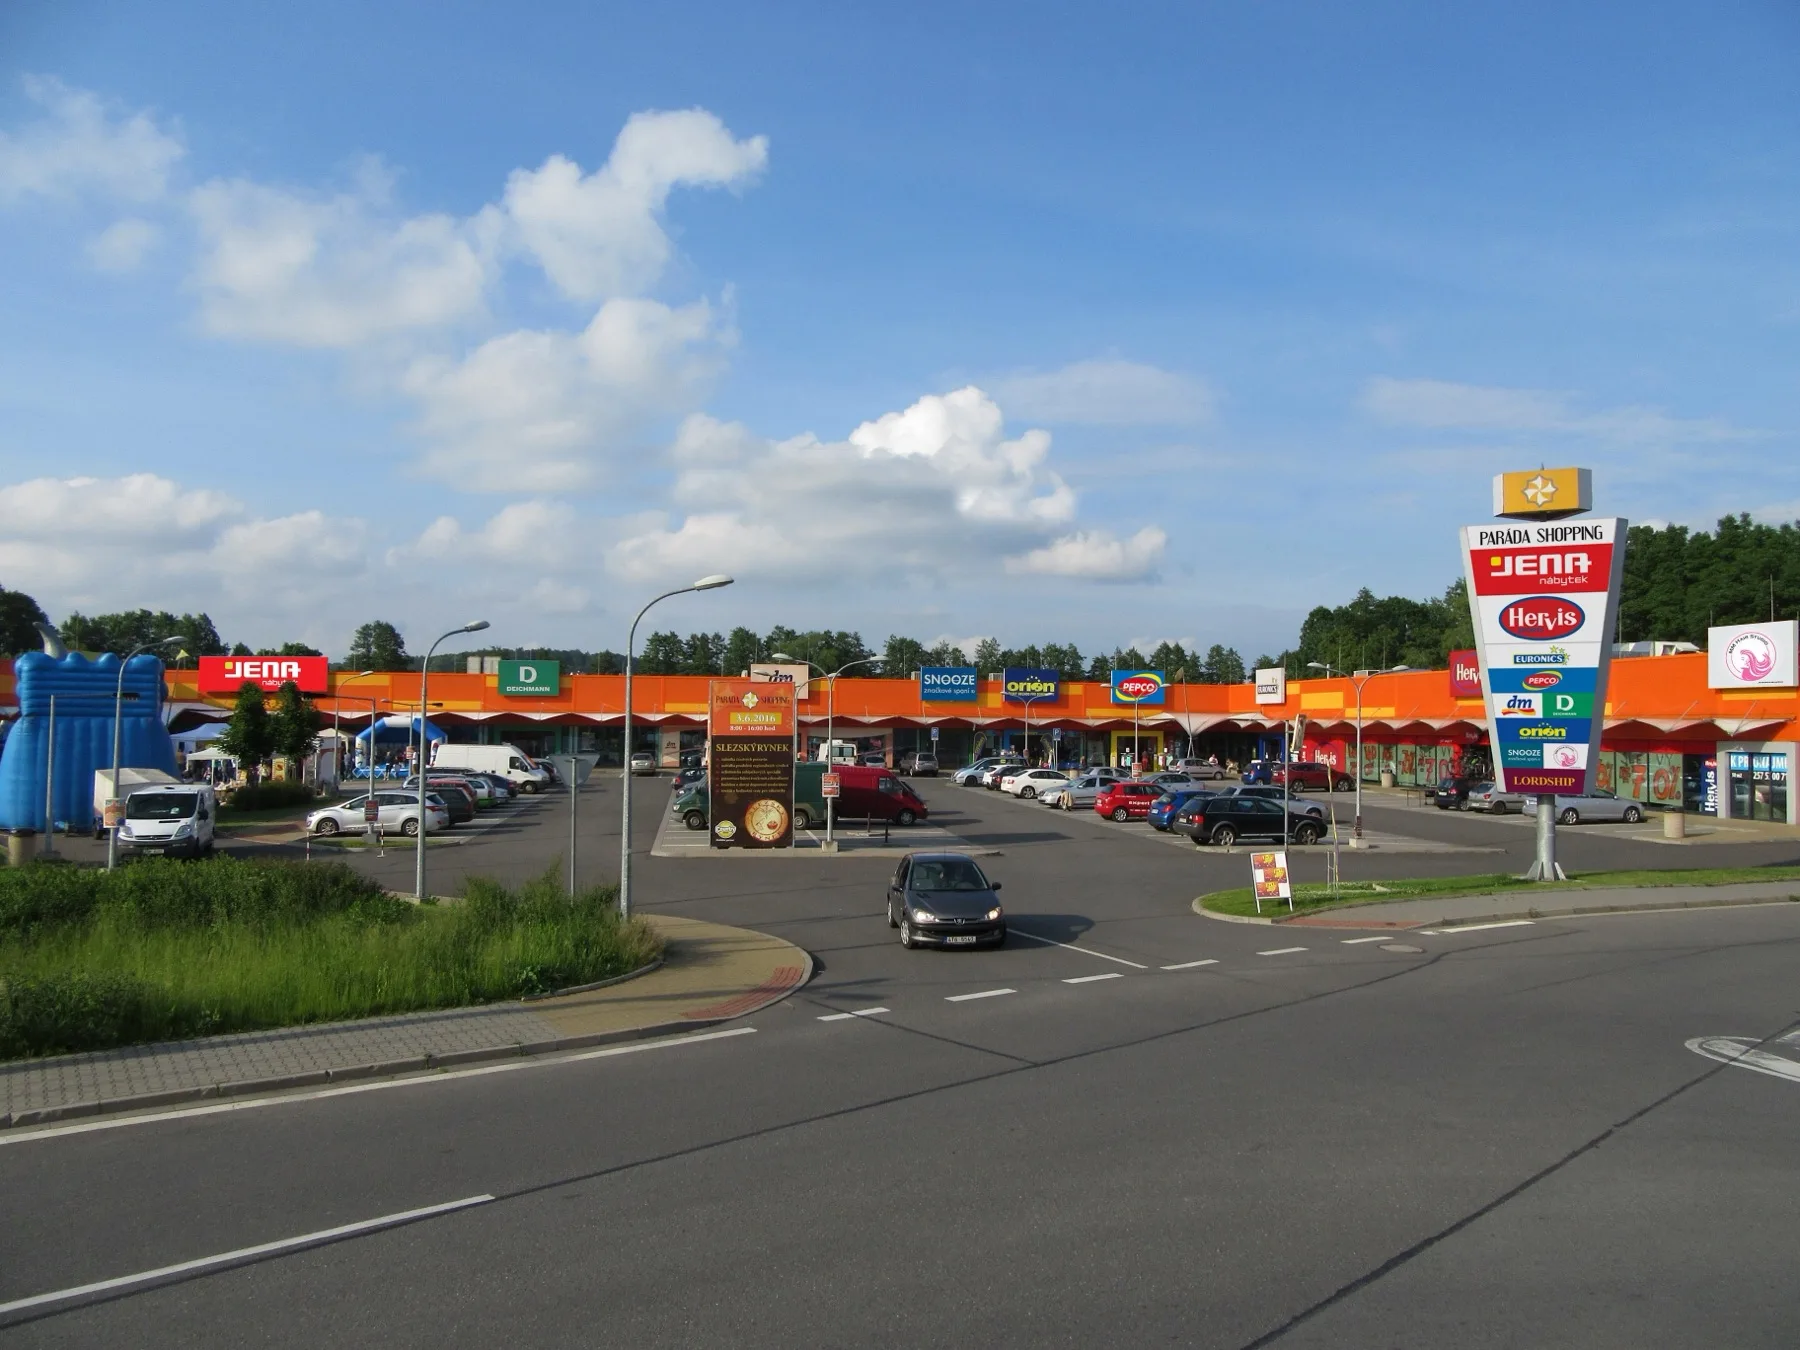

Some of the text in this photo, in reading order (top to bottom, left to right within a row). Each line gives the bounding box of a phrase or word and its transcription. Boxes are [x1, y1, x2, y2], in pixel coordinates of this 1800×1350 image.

[1479, 525, 1603, 546] PARÁDA SHOPPING
[1490, 552, 1592, 577] JENA
[1539, 575, 1589, 586] nábytek
[1508, 607, 1578, 631] Hervis
[1515, 654, 1563, 663] EURONICS
[224, 661, 301, 678] JENA
[519, 665, 538, 684] D
[1456, 663, 1480, 685] Herv
[261, 679, 298, 688] nábyt
[923, 674, 975, 685] SNOOZE
[1006, 679, 1056, 693] orion
[1528, 677, 1557, 685] PEPCO
[1122, 682, 1155, 692] PEPCO
[1507, 695, 1533, 709] dm
[1556, 694, 1575, 711] D
[736, 712, 777, 723] 3.6.2016
[1519, 726, 1567, 737] orion
[1507, 749, 1541, 757] SNOOZE
[1513, 775, 1576, 787] LORDSHIP
[1704, 770, 1717, 812] Hervis
